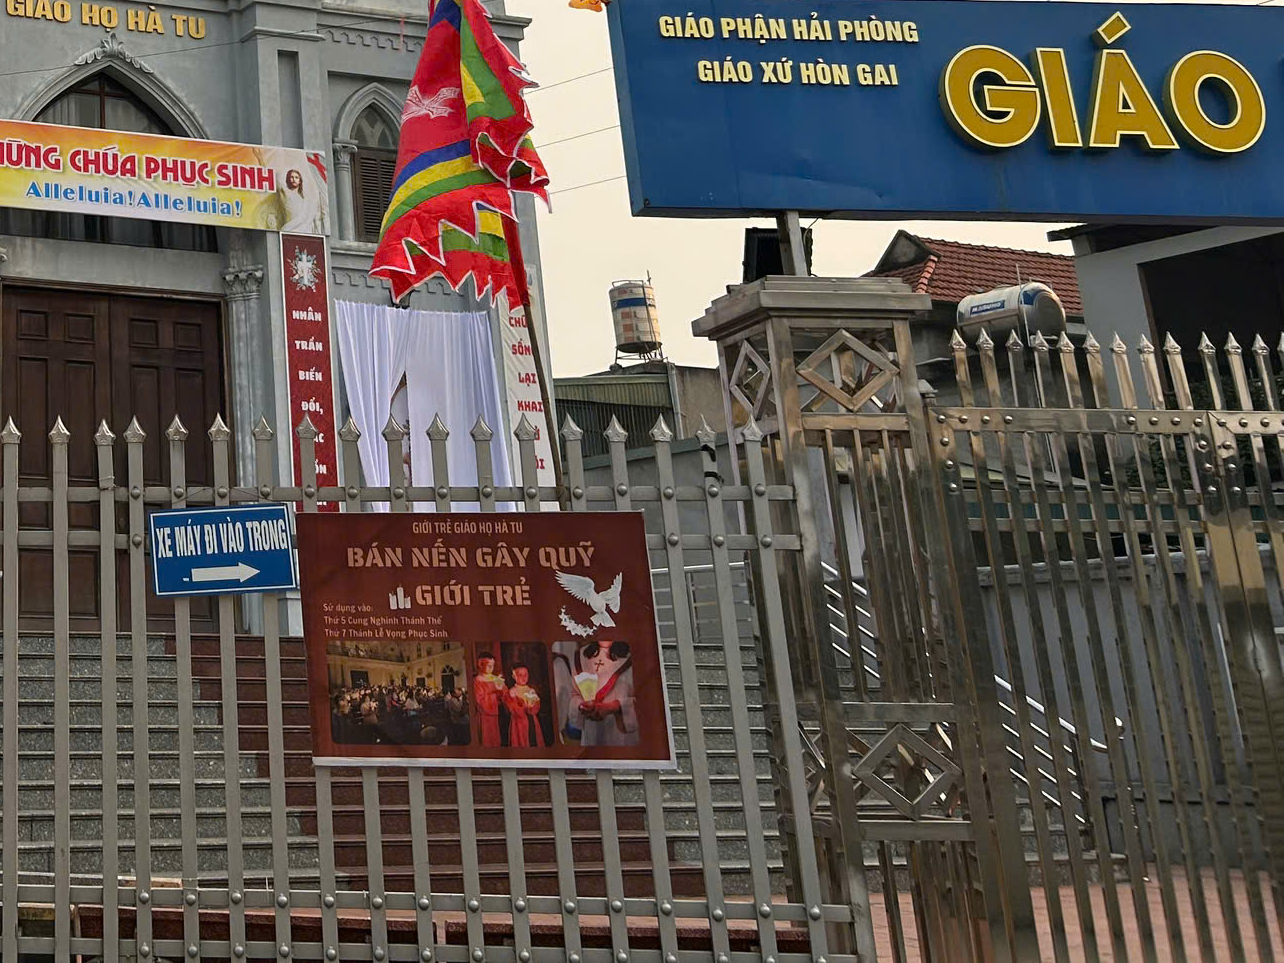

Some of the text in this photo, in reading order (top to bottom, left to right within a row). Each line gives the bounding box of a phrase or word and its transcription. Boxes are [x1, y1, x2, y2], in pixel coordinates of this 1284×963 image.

[81, 2, 118, 32] HỌ
[127, 4, 164, 34] HÀ
[172, 13, 207, 39] TU
[659, 11, 919, 44] GIÁO PHẬN HẢI PHÒNG
[697, 56, 899, 86] GIÁO XỨ HÒN GAI
[941, 11, 1266, 153] GIÁO
[69, 146, 137, 177] CHÚA
[145, 155, 210, 188] PHỤC
[216, 164, 276, 192] SINH
[292, 307, 322, 322] NHÂN
[509, 314, 528, 328] CHÚ
[512, 339, 534, 355] SỐN
[298, 366, 323, 382] BIẾN
[518, 372, 537, 387] LẠI
[517, 400, 543, 413] KHAI
[412, 518, 523, 536] GIỚI TRẺ GIÁO HỌ HÀ TU
[156, 516, 288, 558] XE MÁY ĐI VÀO TRONG
[347, 538, 595, 571] BÁN NẾN GÂY QUỸ
[415, 576, 532, 606] GIỚI TRẺ
[336, 603, 356, 613] dụng
[324, 616, 339, 624] Thứ
[341, 616, 346, 624] 5
[348, 616, 368, 626] Cung
[370, 616, 399, 626] Nghinh
[401, 616, 425, 625] Thánh
[342, 628, 346, 637] 7
[349, 628, 373, 637] Thánh
[385, 629, 406, 639] Vọng
[408, 629, 428, 639] Phục
[430, 629, 448, 637] Sinh
